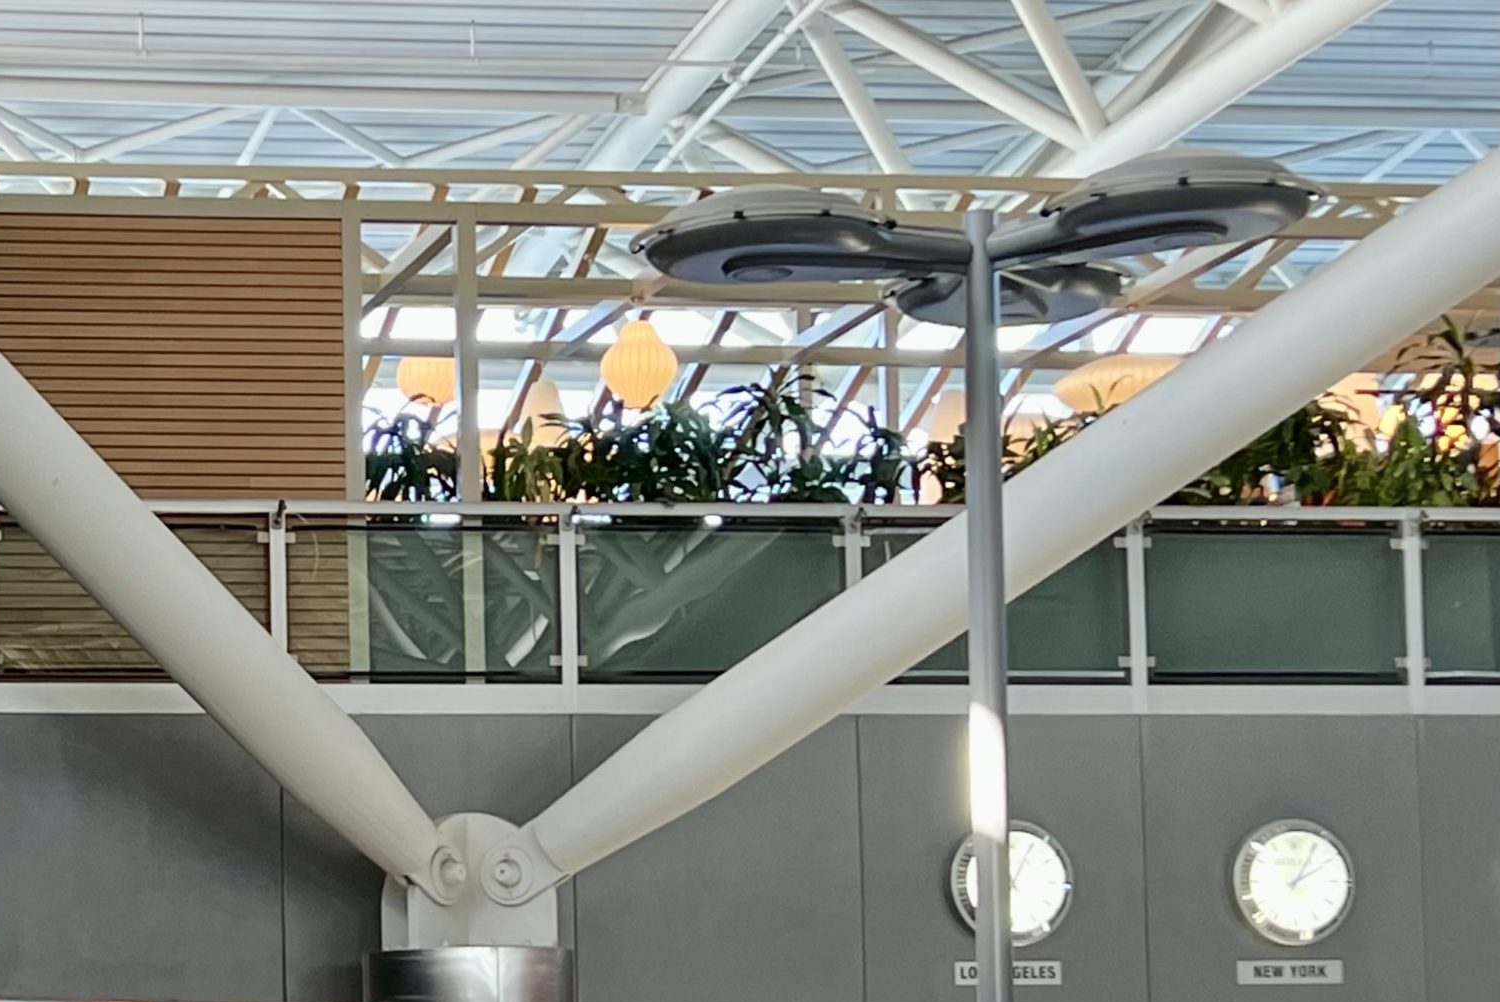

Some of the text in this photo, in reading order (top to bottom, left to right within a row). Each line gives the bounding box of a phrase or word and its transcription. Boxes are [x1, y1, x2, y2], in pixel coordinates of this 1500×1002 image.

[1011, 966, 1056, 979] GELES
[1253, 964, 1328, 978] NEW YORK
